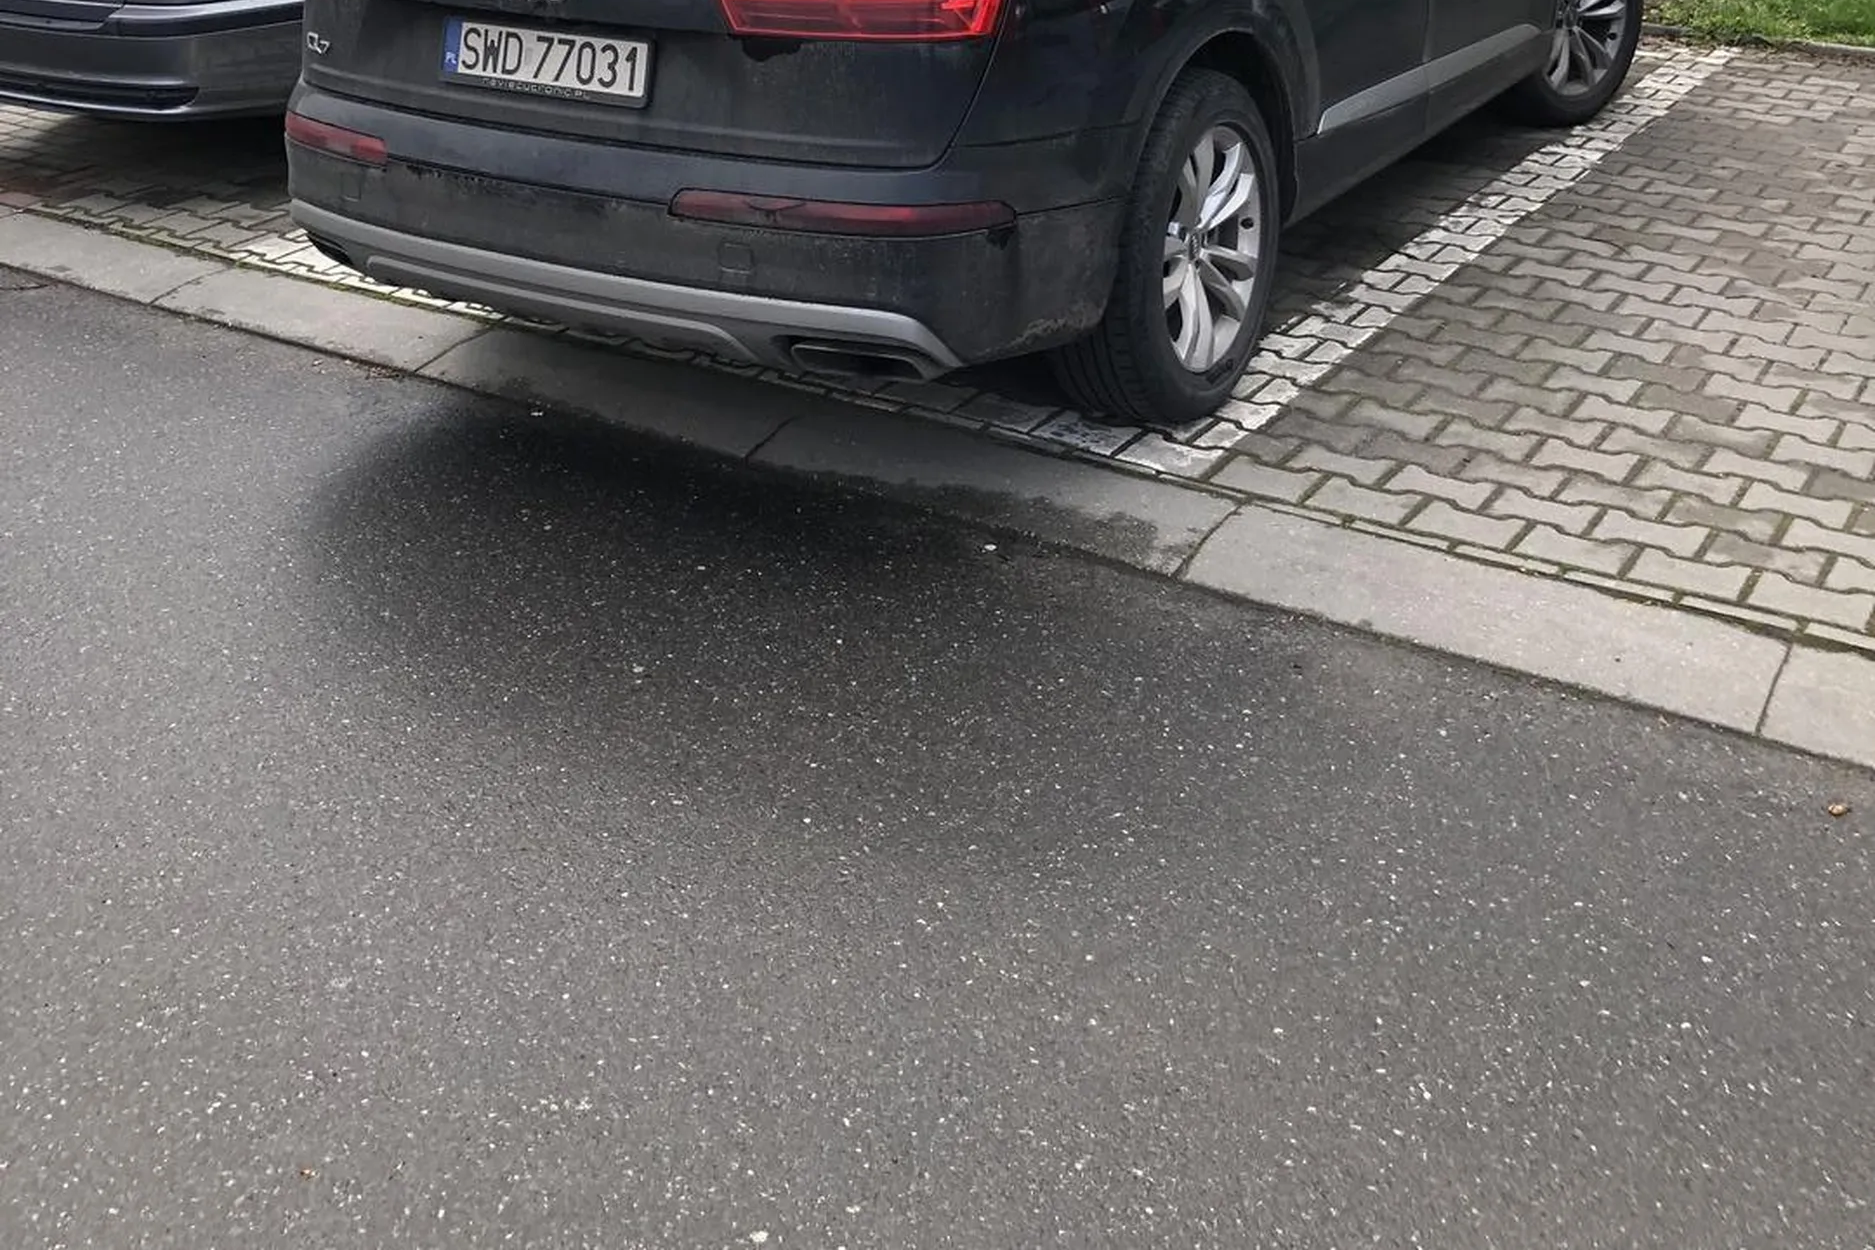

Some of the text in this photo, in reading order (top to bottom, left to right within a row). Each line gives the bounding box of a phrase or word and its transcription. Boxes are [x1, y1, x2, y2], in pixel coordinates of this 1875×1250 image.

[306, 31, 330, 54] Q7
[445, 51, 457, 64] PL
[461, 27, 639, 91] SWD 77031
